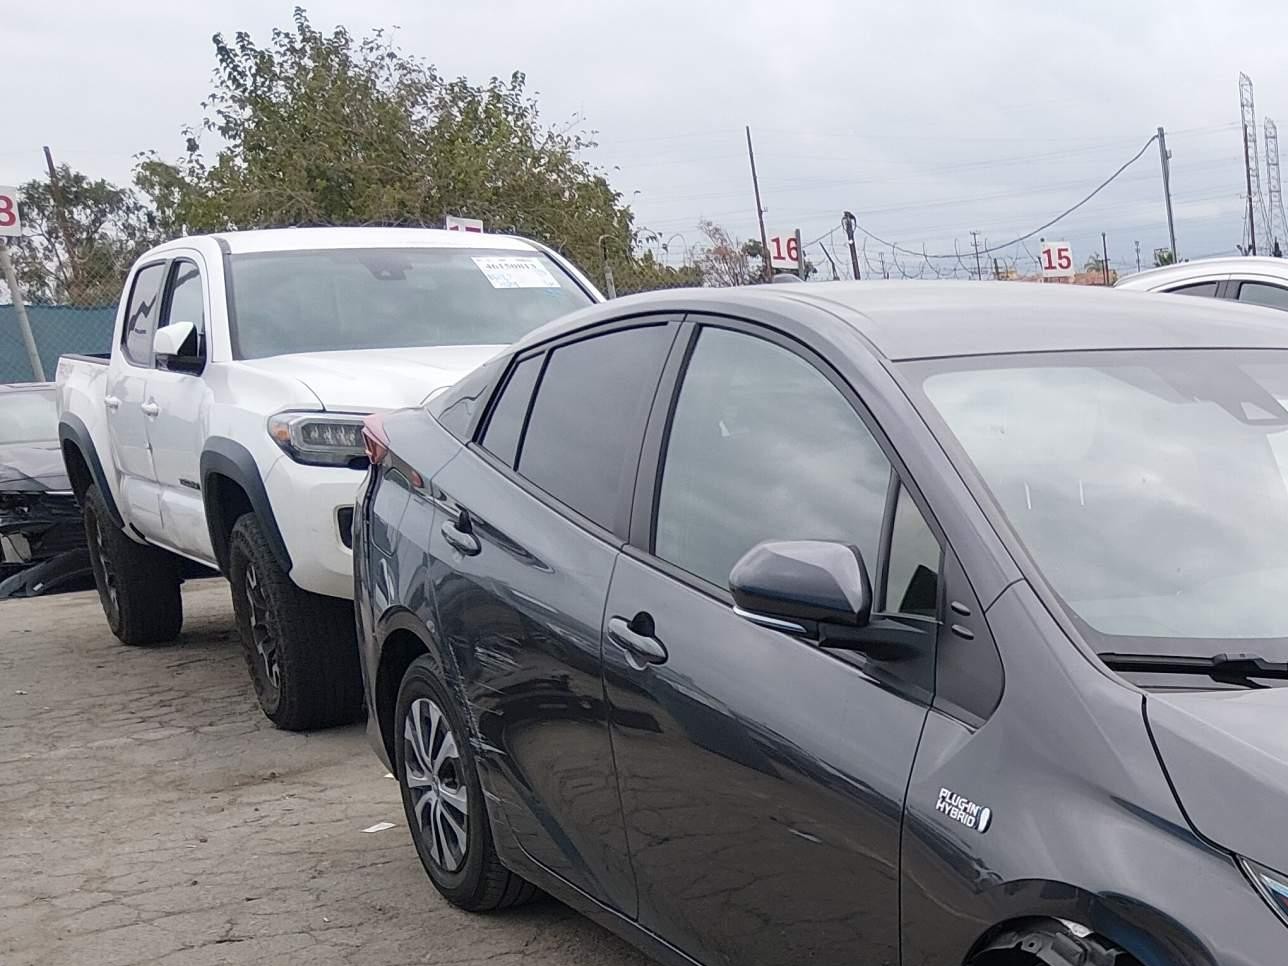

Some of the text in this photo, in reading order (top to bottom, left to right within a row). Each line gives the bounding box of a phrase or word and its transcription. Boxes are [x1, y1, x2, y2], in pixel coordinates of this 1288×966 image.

[771, 236, 799, 262] 16
[1042, 248, 1072, 270] 15
[935, 799, 976, 828] HYBRID
